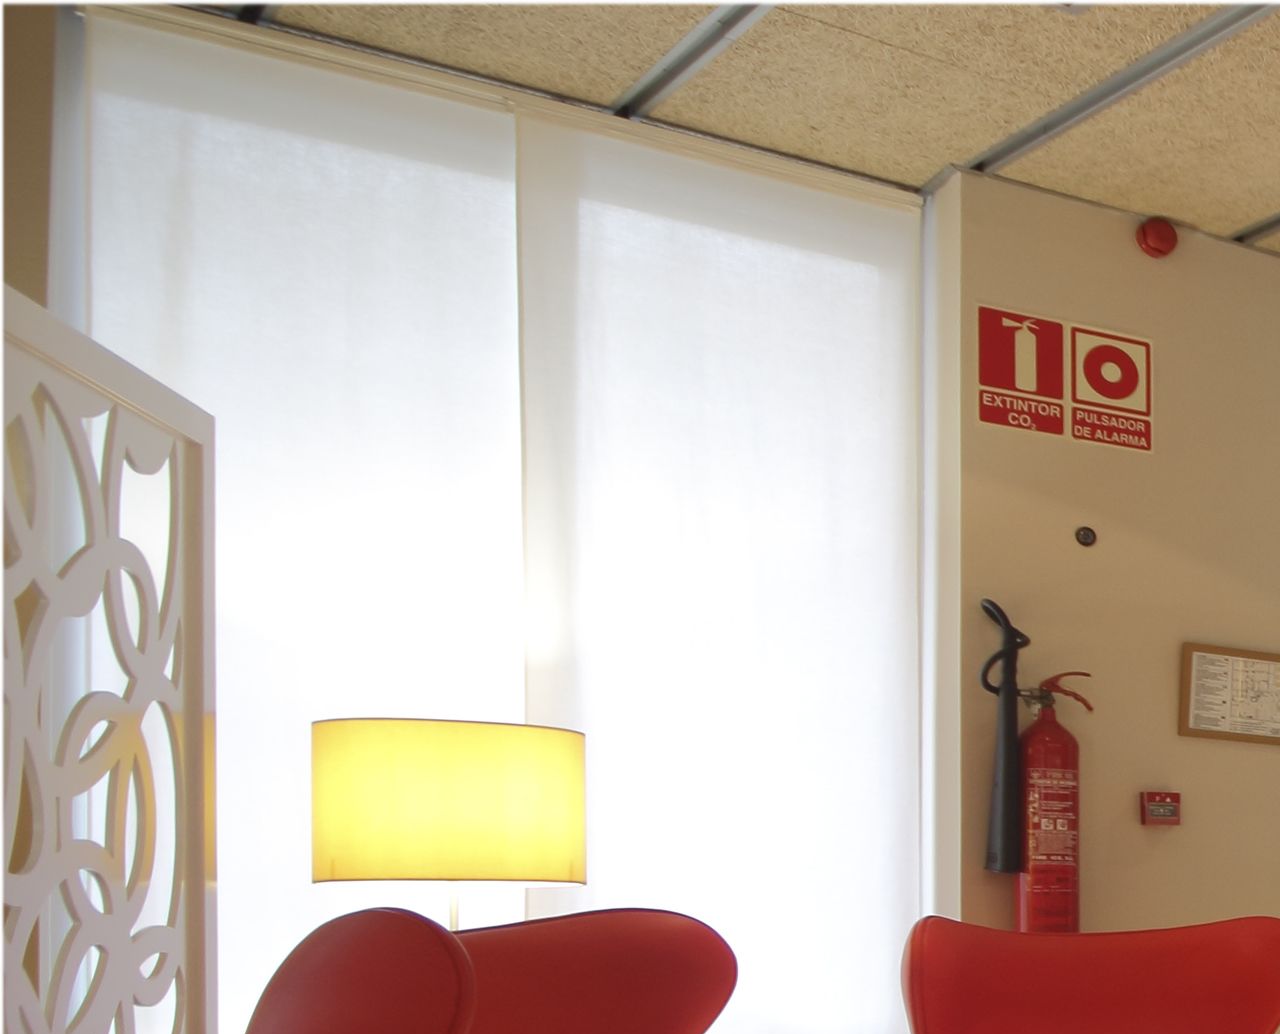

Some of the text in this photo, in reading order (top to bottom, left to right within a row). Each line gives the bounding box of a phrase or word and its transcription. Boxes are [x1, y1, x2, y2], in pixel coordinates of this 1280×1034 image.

[982, 392, 1061, 418] EXTINTOR
[1076, 410, 1145, 432] PULSADOR
[1074, 425, 1148, 447] DE ALARMA
